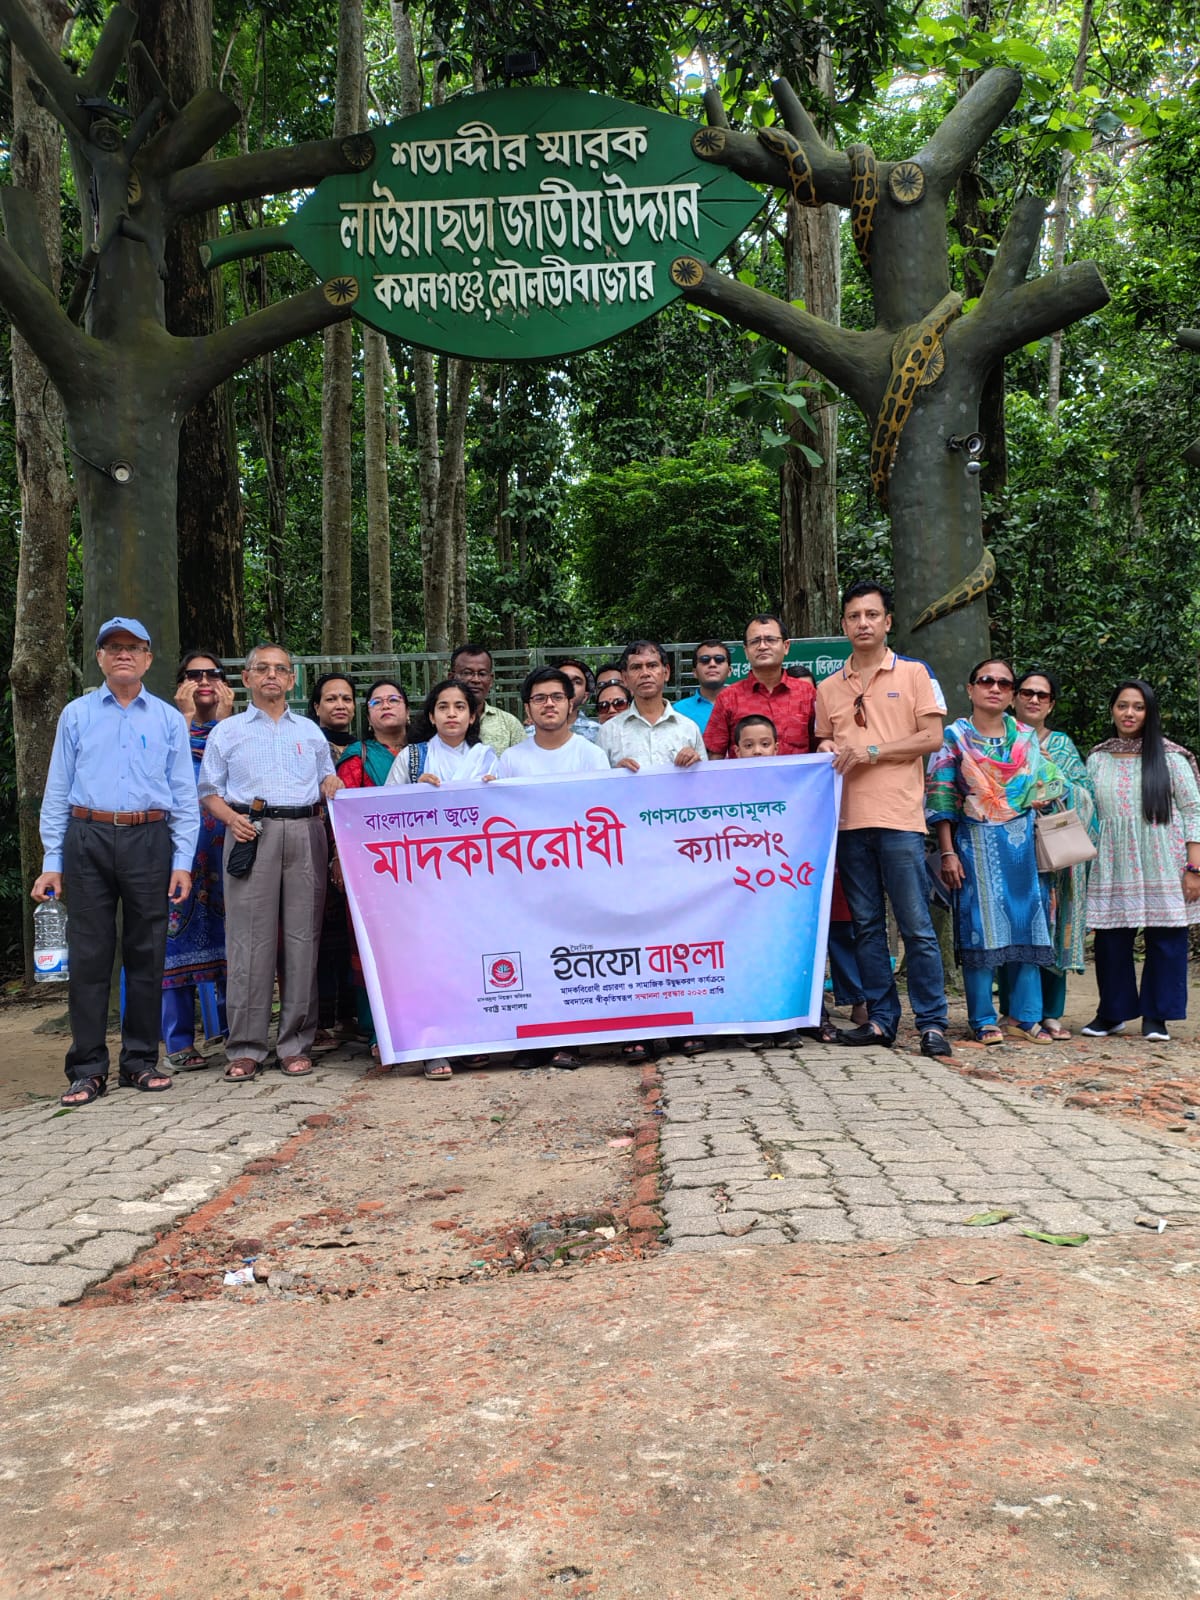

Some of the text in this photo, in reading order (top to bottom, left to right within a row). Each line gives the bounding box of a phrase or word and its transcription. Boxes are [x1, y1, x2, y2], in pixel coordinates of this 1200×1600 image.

[391, 121, 648, 175] শতাব্দীর স্মারক
[339, 171, 702, 265] লাউয়াছড়া জাতীয় উদ্যান
[487, 255, 656, 311] মৌলভীবাজার
[364, 806, 480, 831] বাংলাদেশ জুড়ে
[639, 801, 786, 826] গণসচেতনতামূলক
[364, 806, 627, 884] মাদকবিরোধী
[673, 825, 789, 863] ক্যাম্পিং
[733, 861, 816, 893] ২০২৫
[550, 941, 725, 981] ইনফো বাংলা
[560, 983, 601, 995] মাদকবিরোধী
